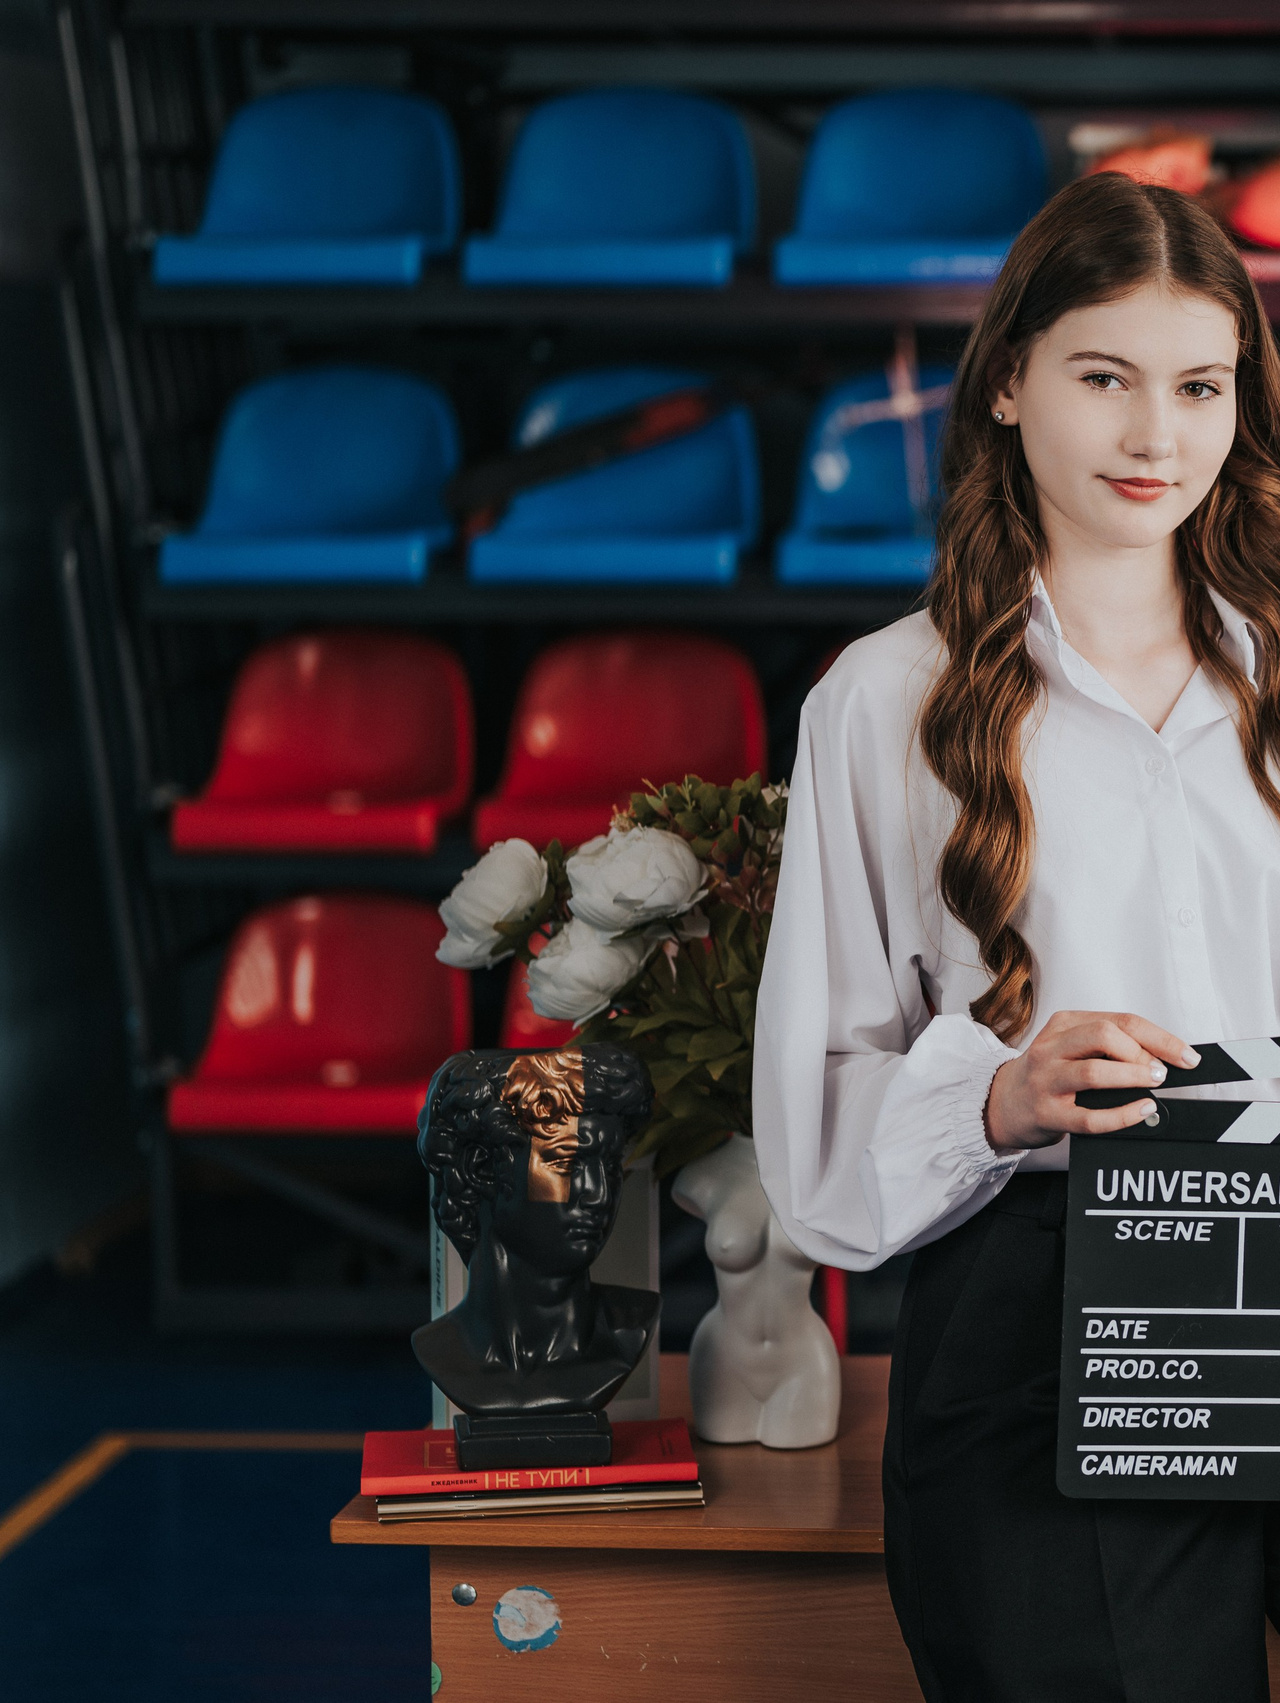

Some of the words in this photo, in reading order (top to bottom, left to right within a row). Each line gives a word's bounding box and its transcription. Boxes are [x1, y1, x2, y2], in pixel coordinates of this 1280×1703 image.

[1114, 1219, 1214, 1242] SCENE
[1085, 1319, 1150, 1340] DATE
[1085, 1358, 1203, 1380] PROD.CO.
[1082, 1407, 1212, 1429] DIRECTOR
[1081, 1454, 1238, 1476] CAMERAMAN
[431, 1478, 478, 1487] ЕЖЕДНЕВНИК
[495, 1472, 520, 1488] НЕ
